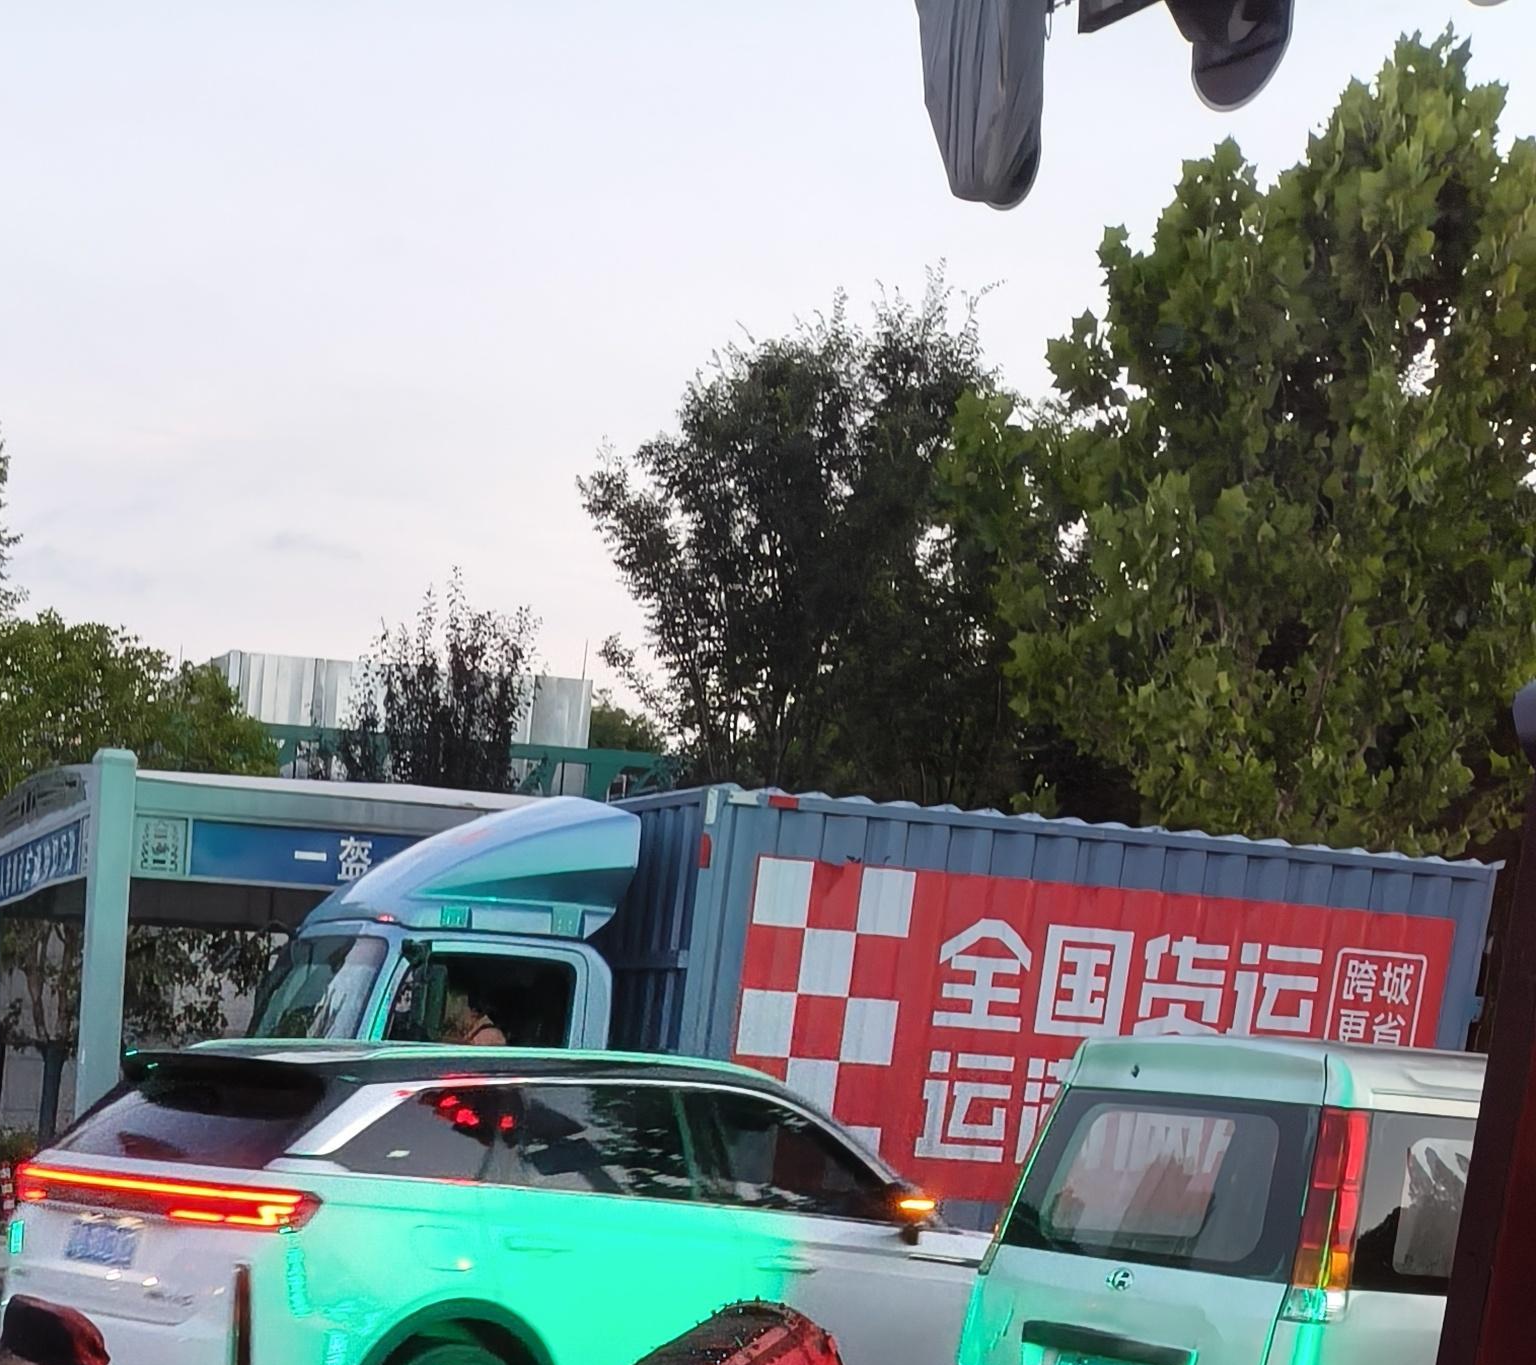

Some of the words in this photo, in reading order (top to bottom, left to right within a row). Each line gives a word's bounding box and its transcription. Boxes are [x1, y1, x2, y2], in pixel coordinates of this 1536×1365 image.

[932, 917, 1323, 1037] 全国货运
[1341, 958, 1415, 1006] 跨城
